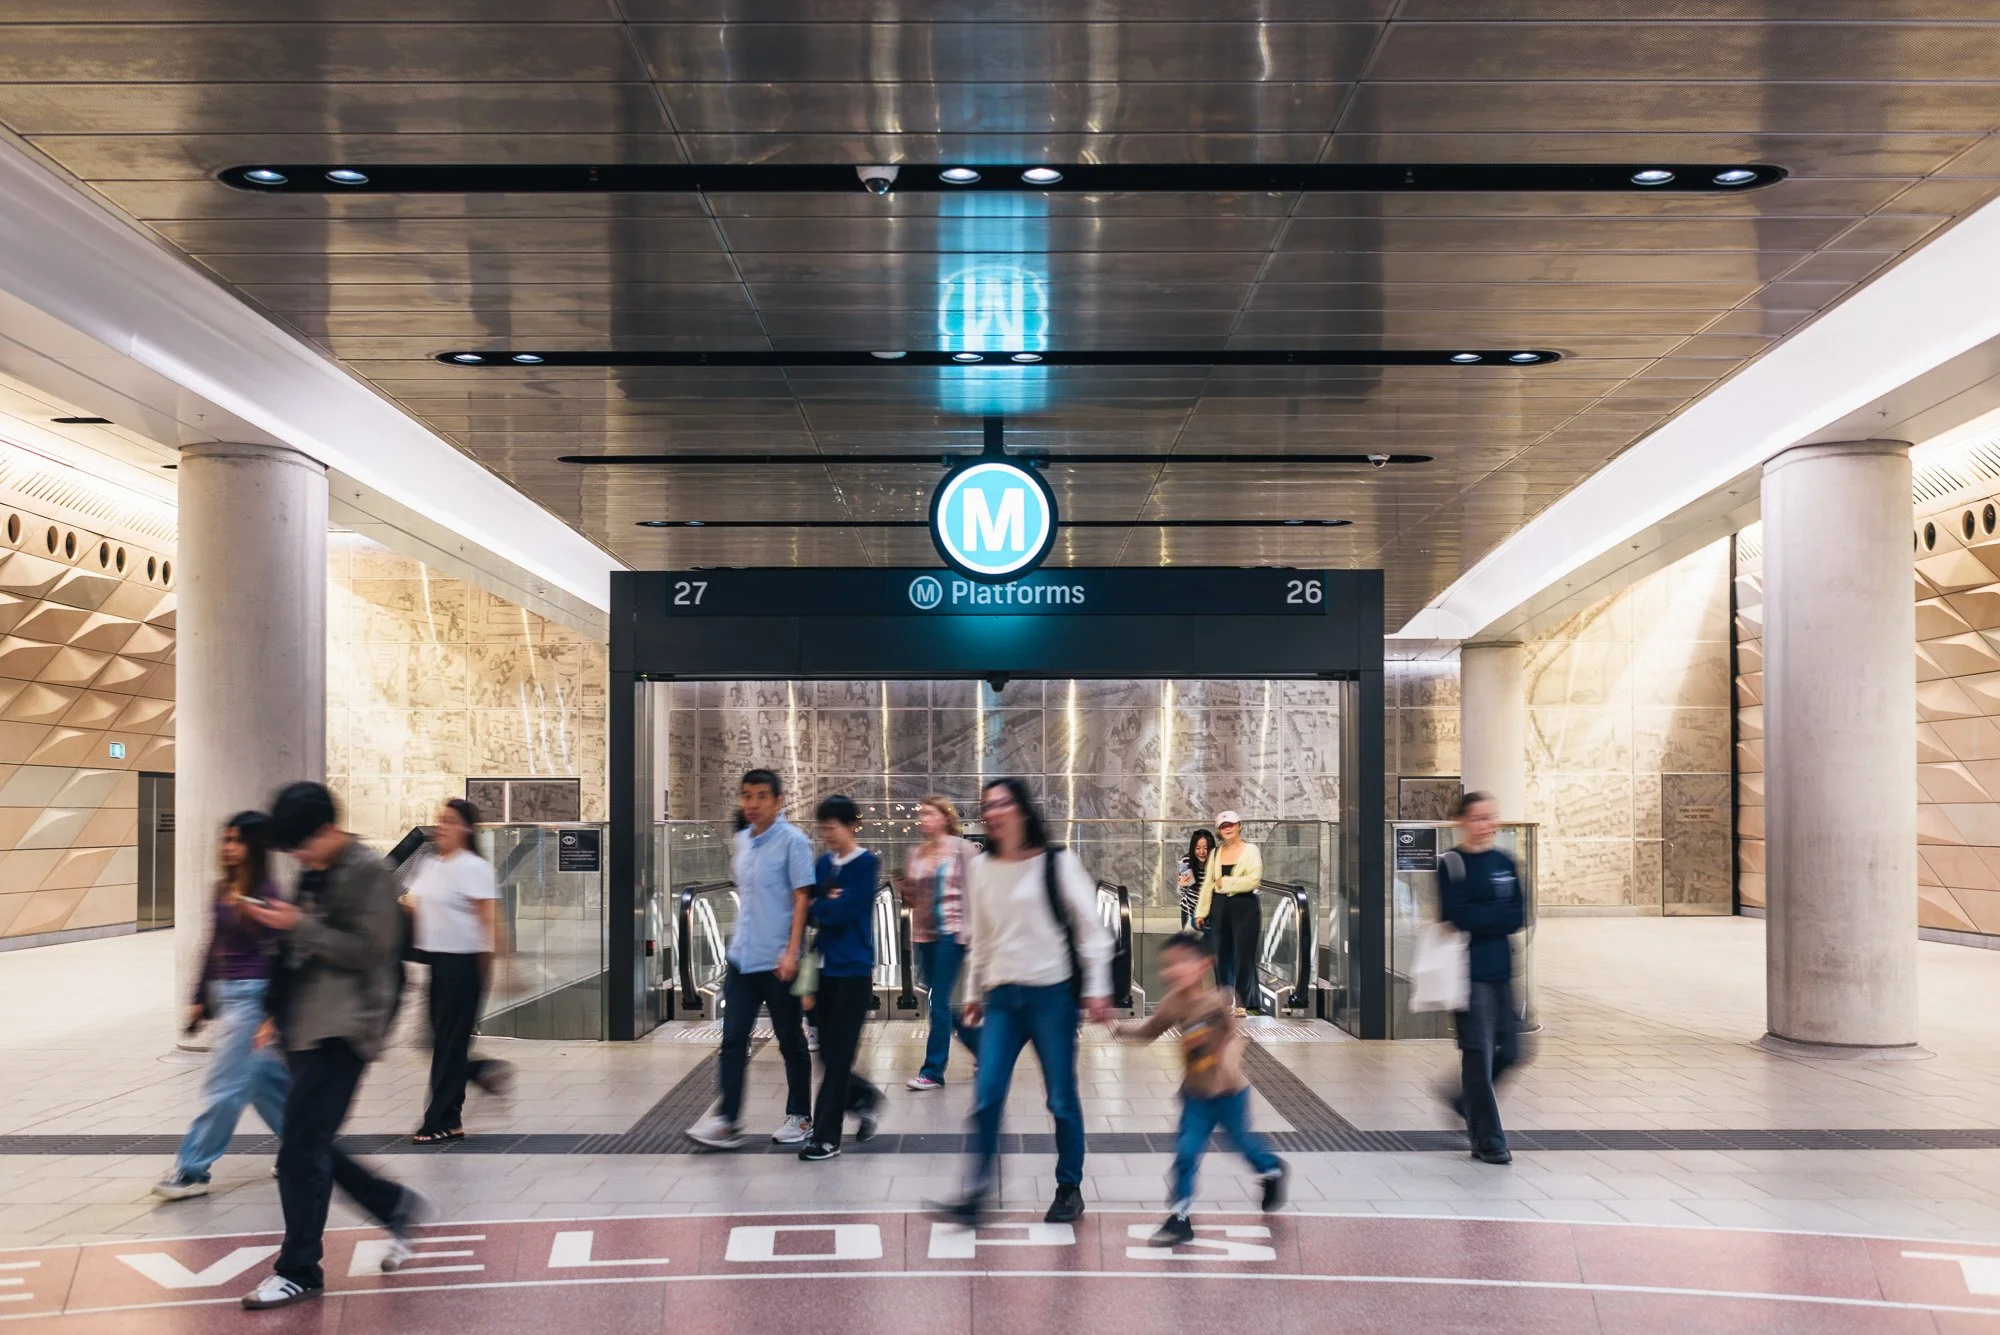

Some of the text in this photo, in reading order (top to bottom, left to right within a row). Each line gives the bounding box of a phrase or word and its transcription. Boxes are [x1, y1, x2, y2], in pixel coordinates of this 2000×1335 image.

[962, 488, 1026, 552] M
[674, 581, 708, 605] 27
[952, 581, 1085, 604] Platforms
[1287, 579, 1323, 604] 26
